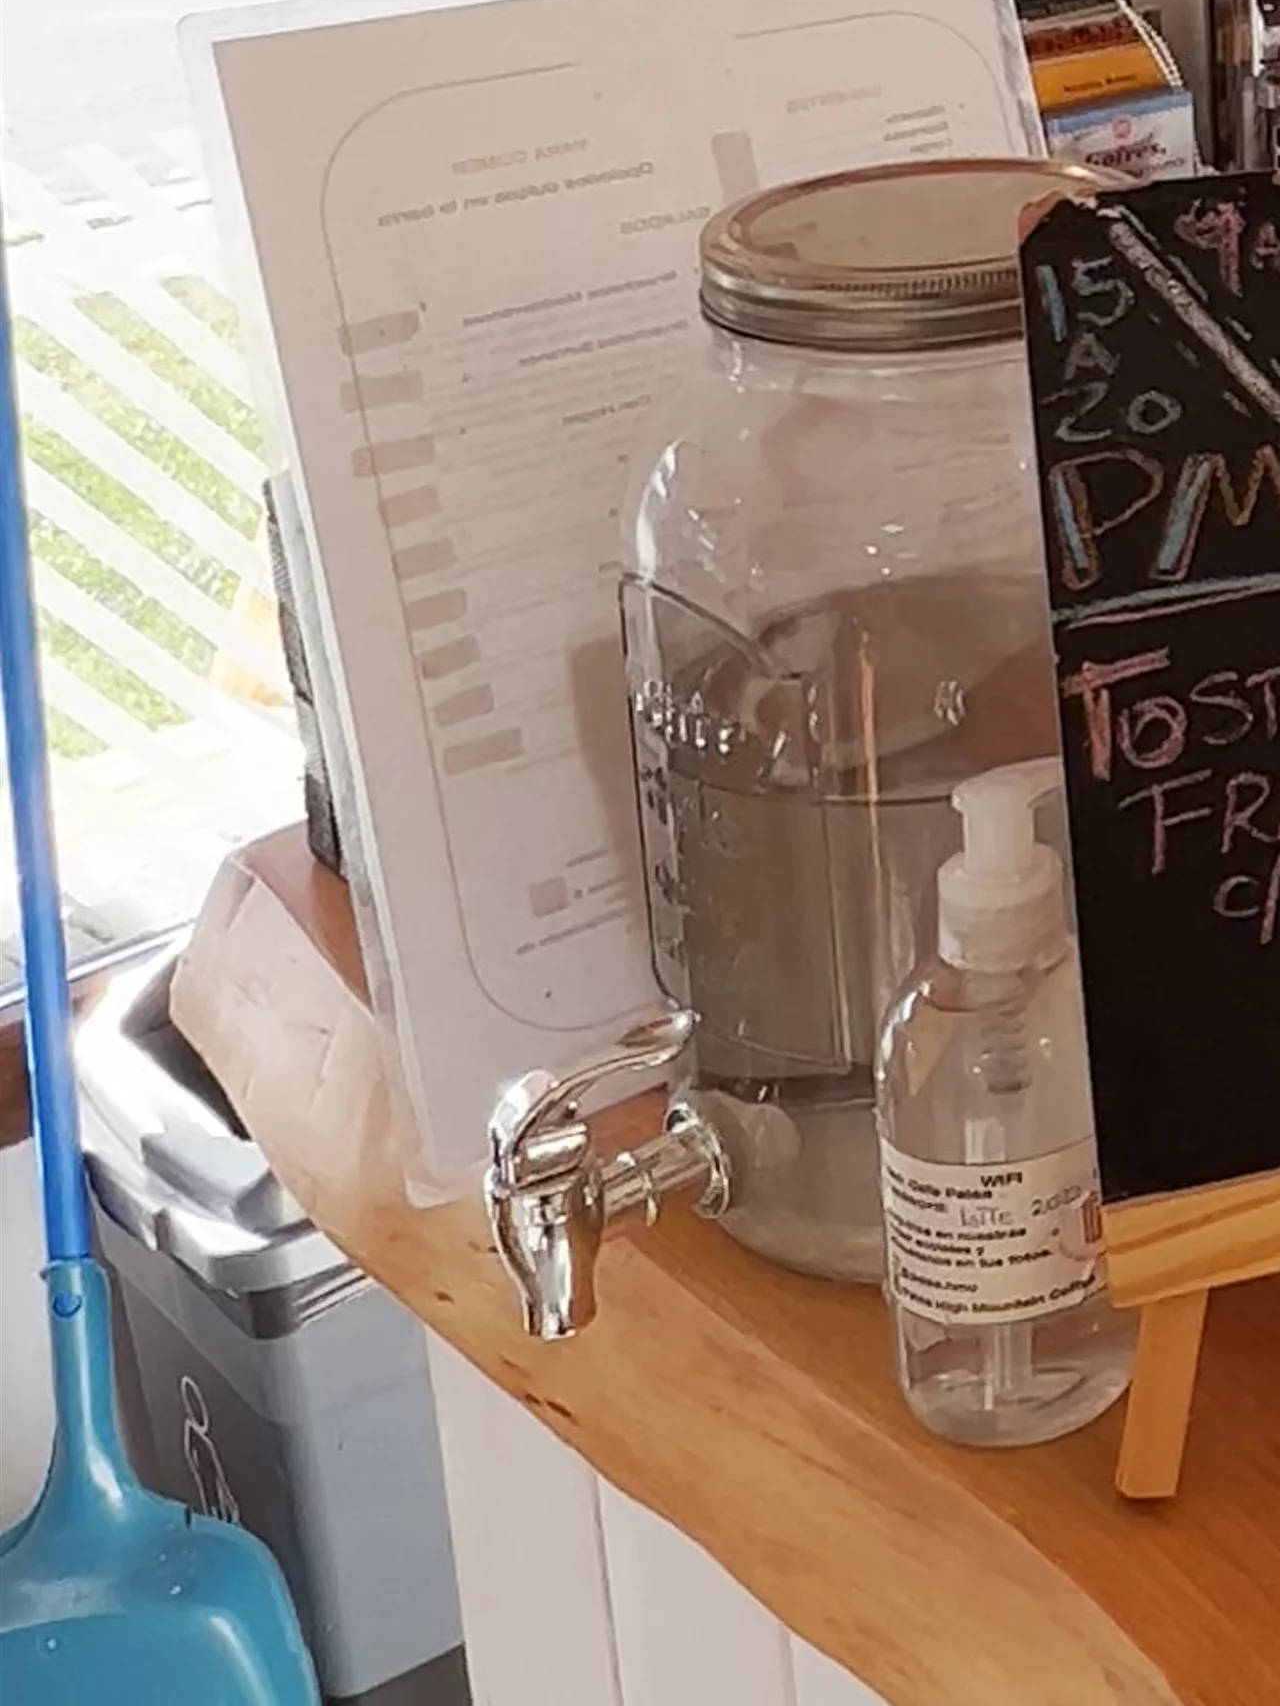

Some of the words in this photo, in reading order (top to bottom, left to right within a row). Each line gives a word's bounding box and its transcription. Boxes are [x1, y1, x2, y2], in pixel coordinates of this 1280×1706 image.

[1038, 257, 1138, 343] 15
[1053, 382, 1185, 443] 20
[980, 1171, 1024, 1188] WIFI
